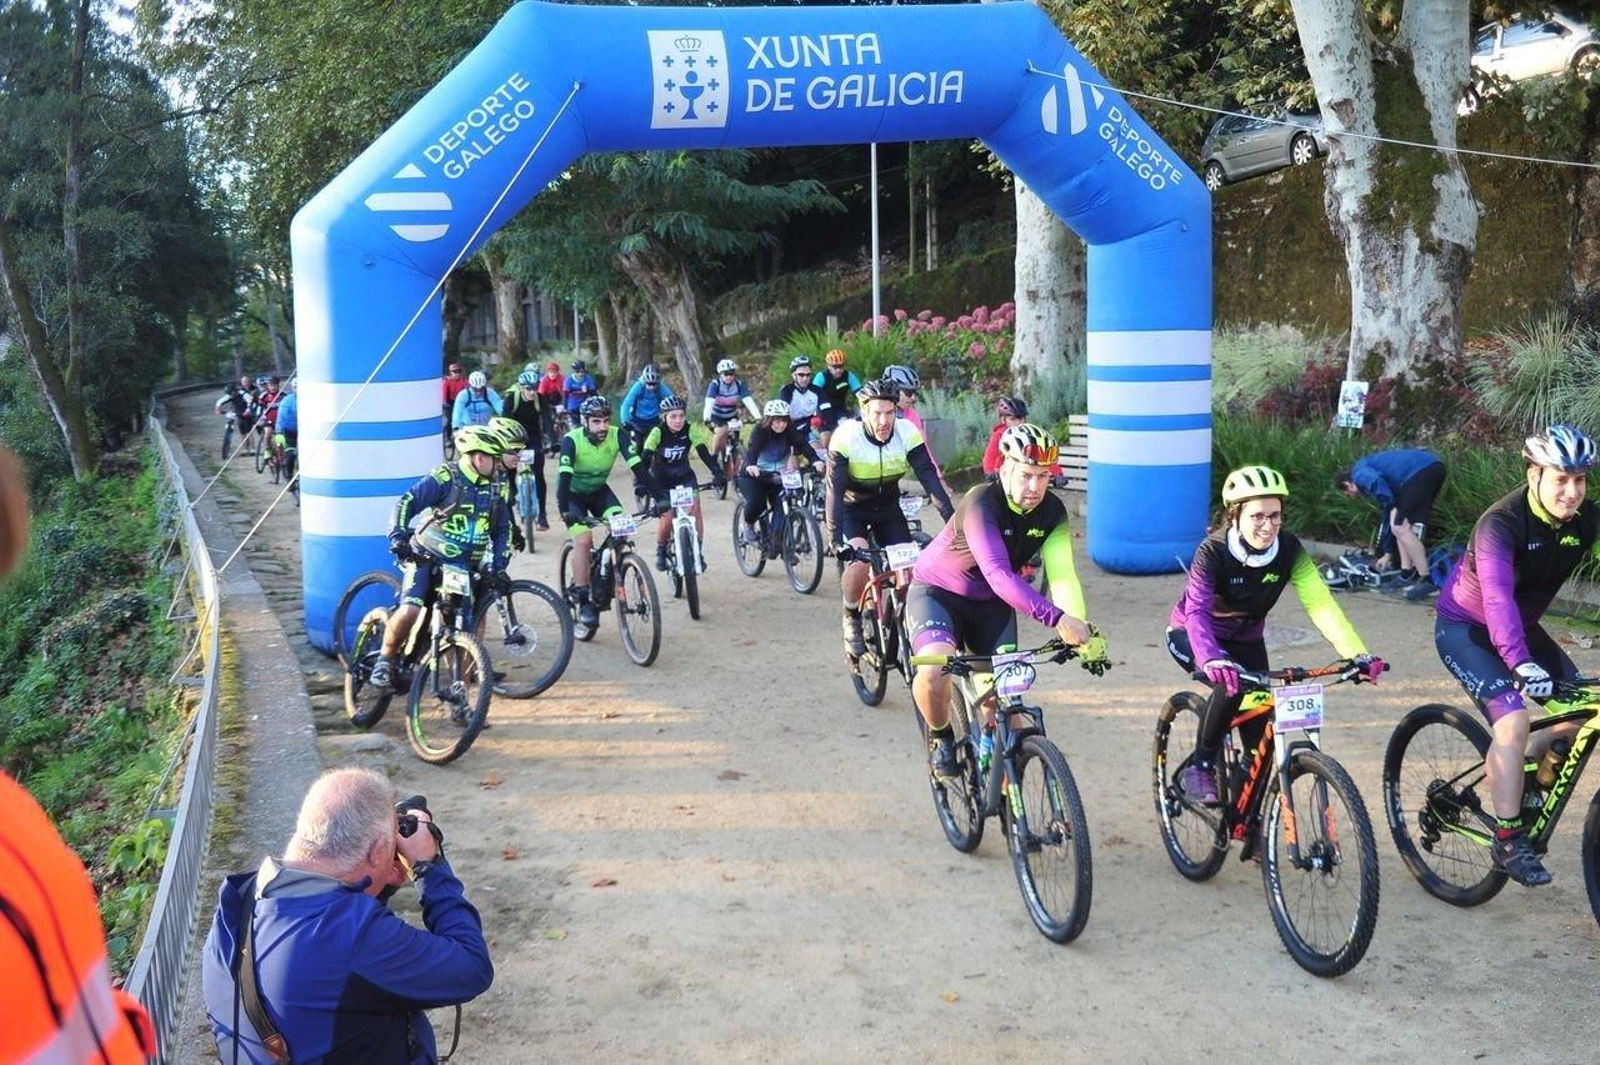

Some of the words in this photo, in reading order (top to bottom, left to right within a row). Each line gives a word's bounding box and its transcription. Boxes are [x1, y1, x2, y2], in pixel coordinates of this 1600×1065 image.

[743, 33, 882, 69] XUNTA
[422, 72, 531, 165] DEPORTE
[745, 77, 795, 112] DE
[806, 70, 964, 110] GALICIA
[442, 99, 535, 180] GALEGO
[1099, 123, 1166, 191] GALEGO
[1107, 105, 1183, 185] DEPORTE
[1287, 698, 1314, 711] 308
